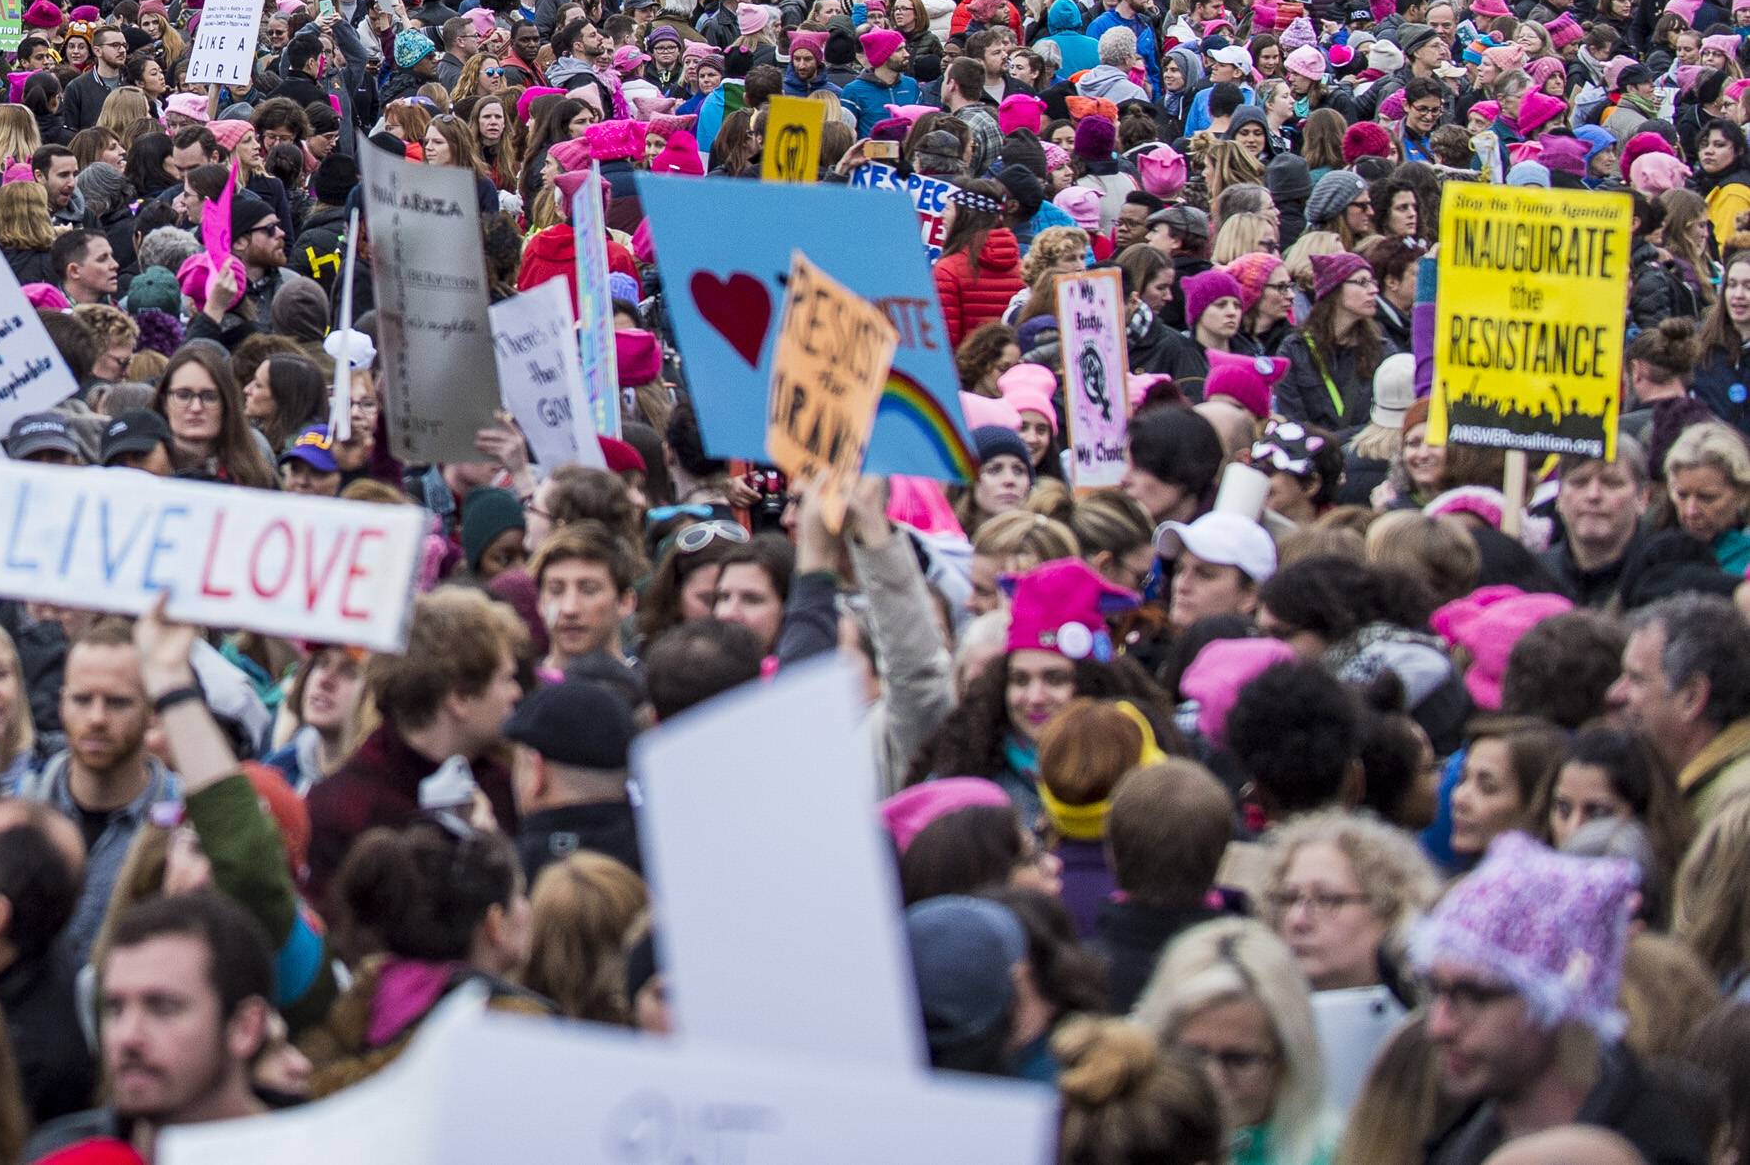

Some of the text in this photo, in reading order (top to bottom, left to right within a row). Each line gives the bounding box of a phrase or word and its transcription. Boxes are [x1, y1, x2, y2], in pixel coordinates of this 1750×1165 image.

[198, 34, 245, 52] LIKE A
[192, 60, 240, 80] GIRL
[1490, 198, 1509, 212] the
[1515, 199, 1554, 218] Trump
[1453, 218, 1618, 278] INAUGURATE
[1509, 279, 1544, 312] the
[1449, 314, 1608, 379] RESISTANCE
[5, 480, 389, 622] LIVE LOVE
